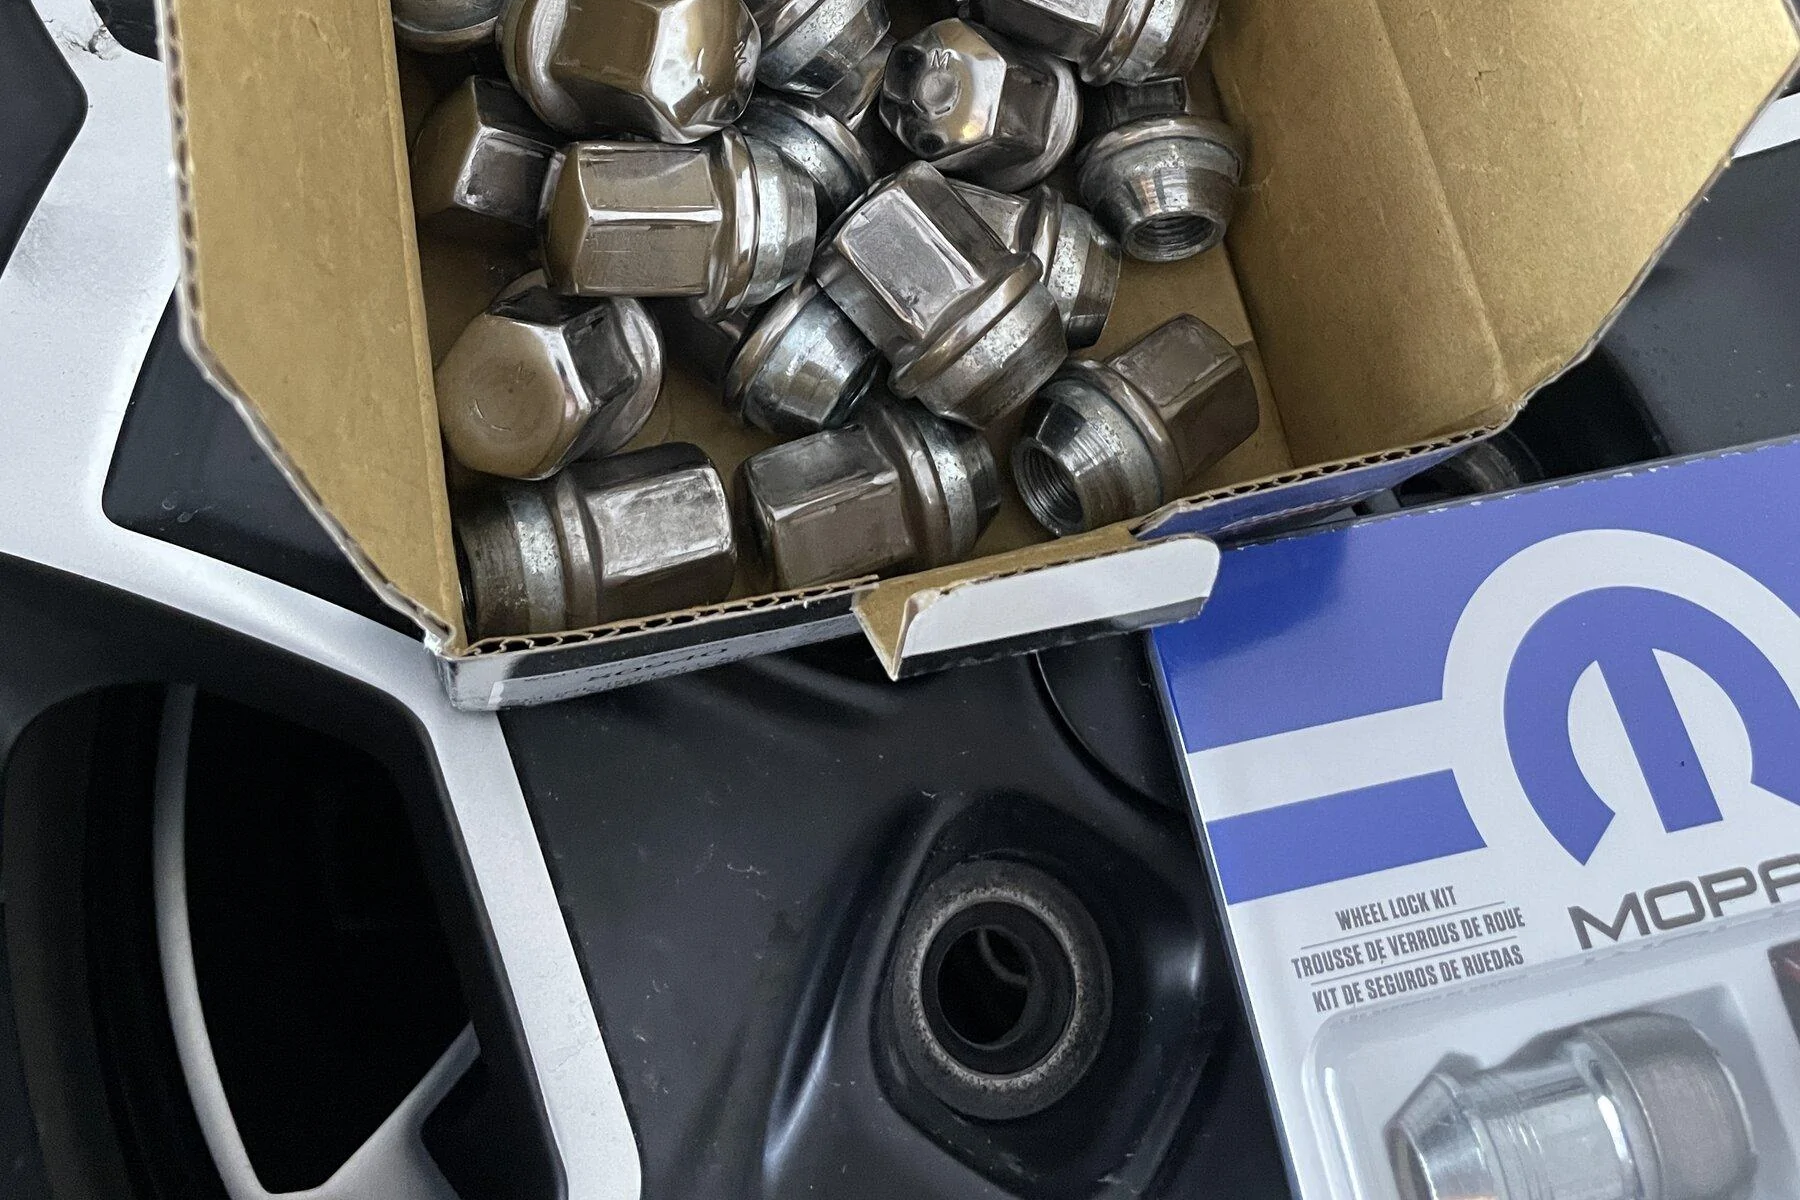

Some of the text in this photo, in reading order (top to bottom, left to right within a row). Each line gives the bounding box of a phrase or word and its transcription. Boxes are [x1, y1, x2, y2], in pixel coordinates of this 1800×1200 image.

[1291, 906, 1526, 980] TROUSSE DE VERROUS DE ROUE
[1335, 885, 1458, 932] WHEEL LOCK KIT
[1312, 943, 1525, 1013] KIT DE SEGUROS DE RUEDAS
